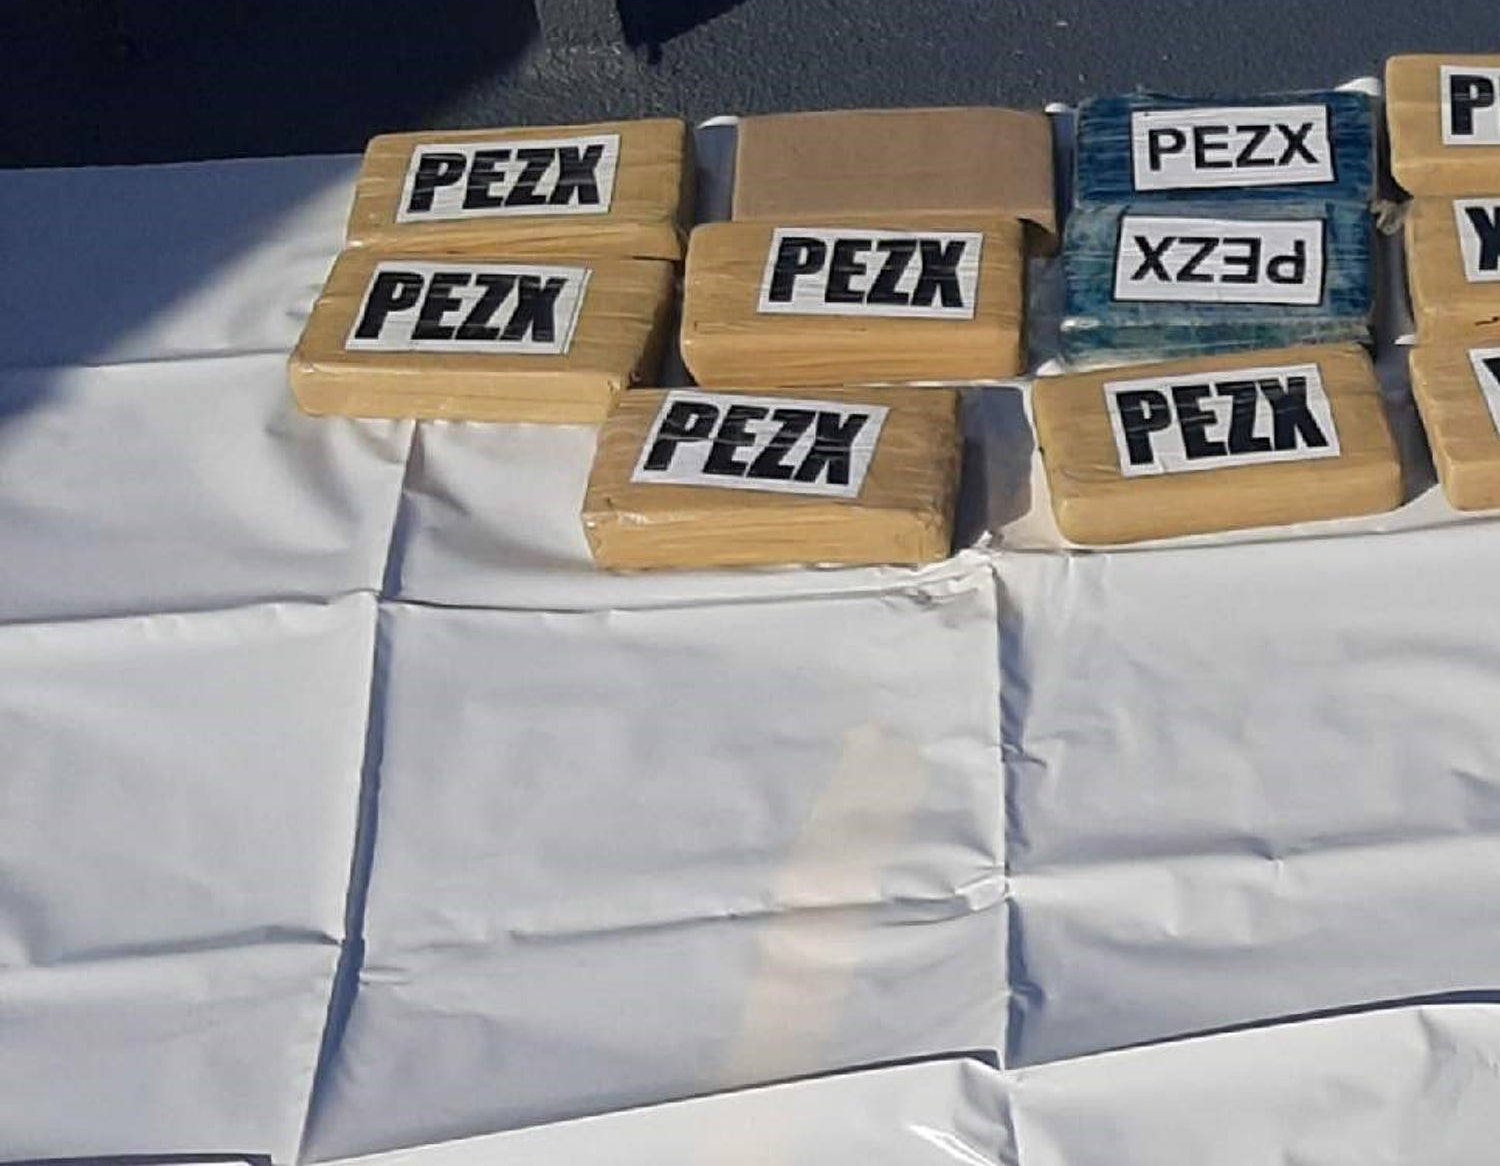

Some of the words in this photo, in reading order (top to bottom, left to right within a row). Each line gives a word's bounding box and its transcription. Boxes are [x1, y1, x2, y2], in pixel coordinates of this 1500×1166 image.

[407, 145, 604, 213] PEZX
[1149, 123, 1318, 170] PEZX
[769, 237, 966, 307] PEZX
[1131, 236, 1305, 284] PEZX
[355, 272, 567, 342] PEZX
[644, 401, 869, 485] PEZX
[1116, 377, 1328, 465] PEZX
